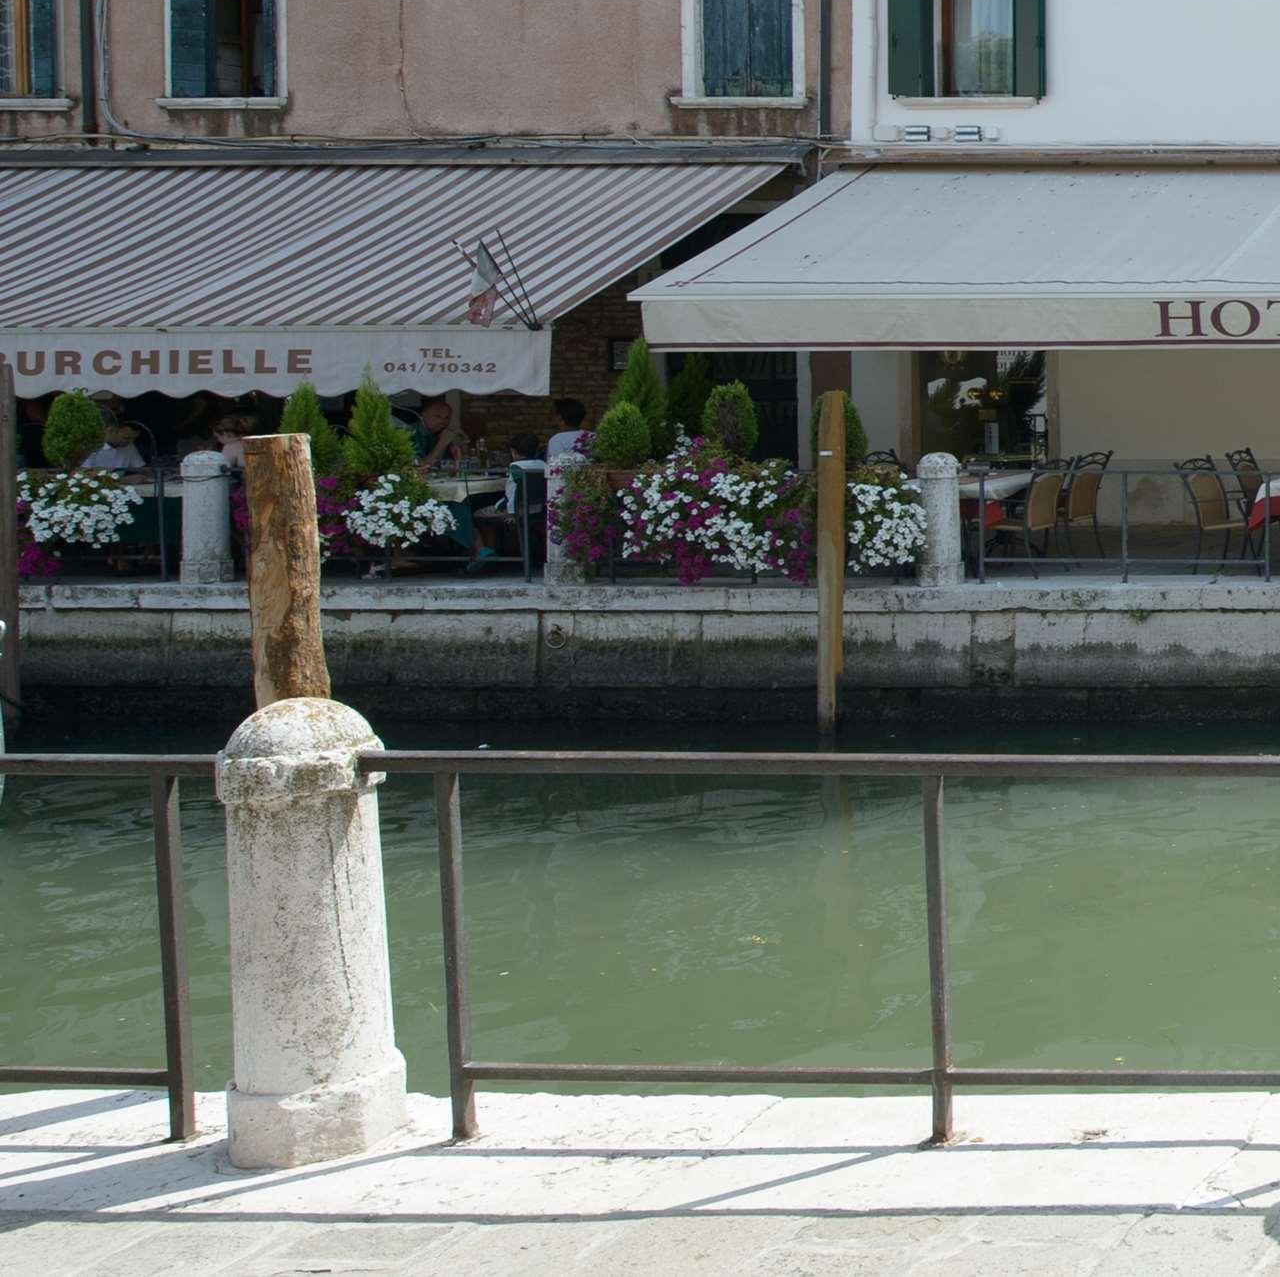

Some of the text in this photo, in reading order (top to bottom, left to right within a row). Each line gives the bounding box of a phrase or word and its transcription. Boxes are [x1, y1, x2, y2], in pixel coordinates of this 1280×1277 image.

[419, 347, 462, 359] TEL.
[0, 349, 313, 376] URCHIELLE
[384, 362, 497, 374] 041/710342
